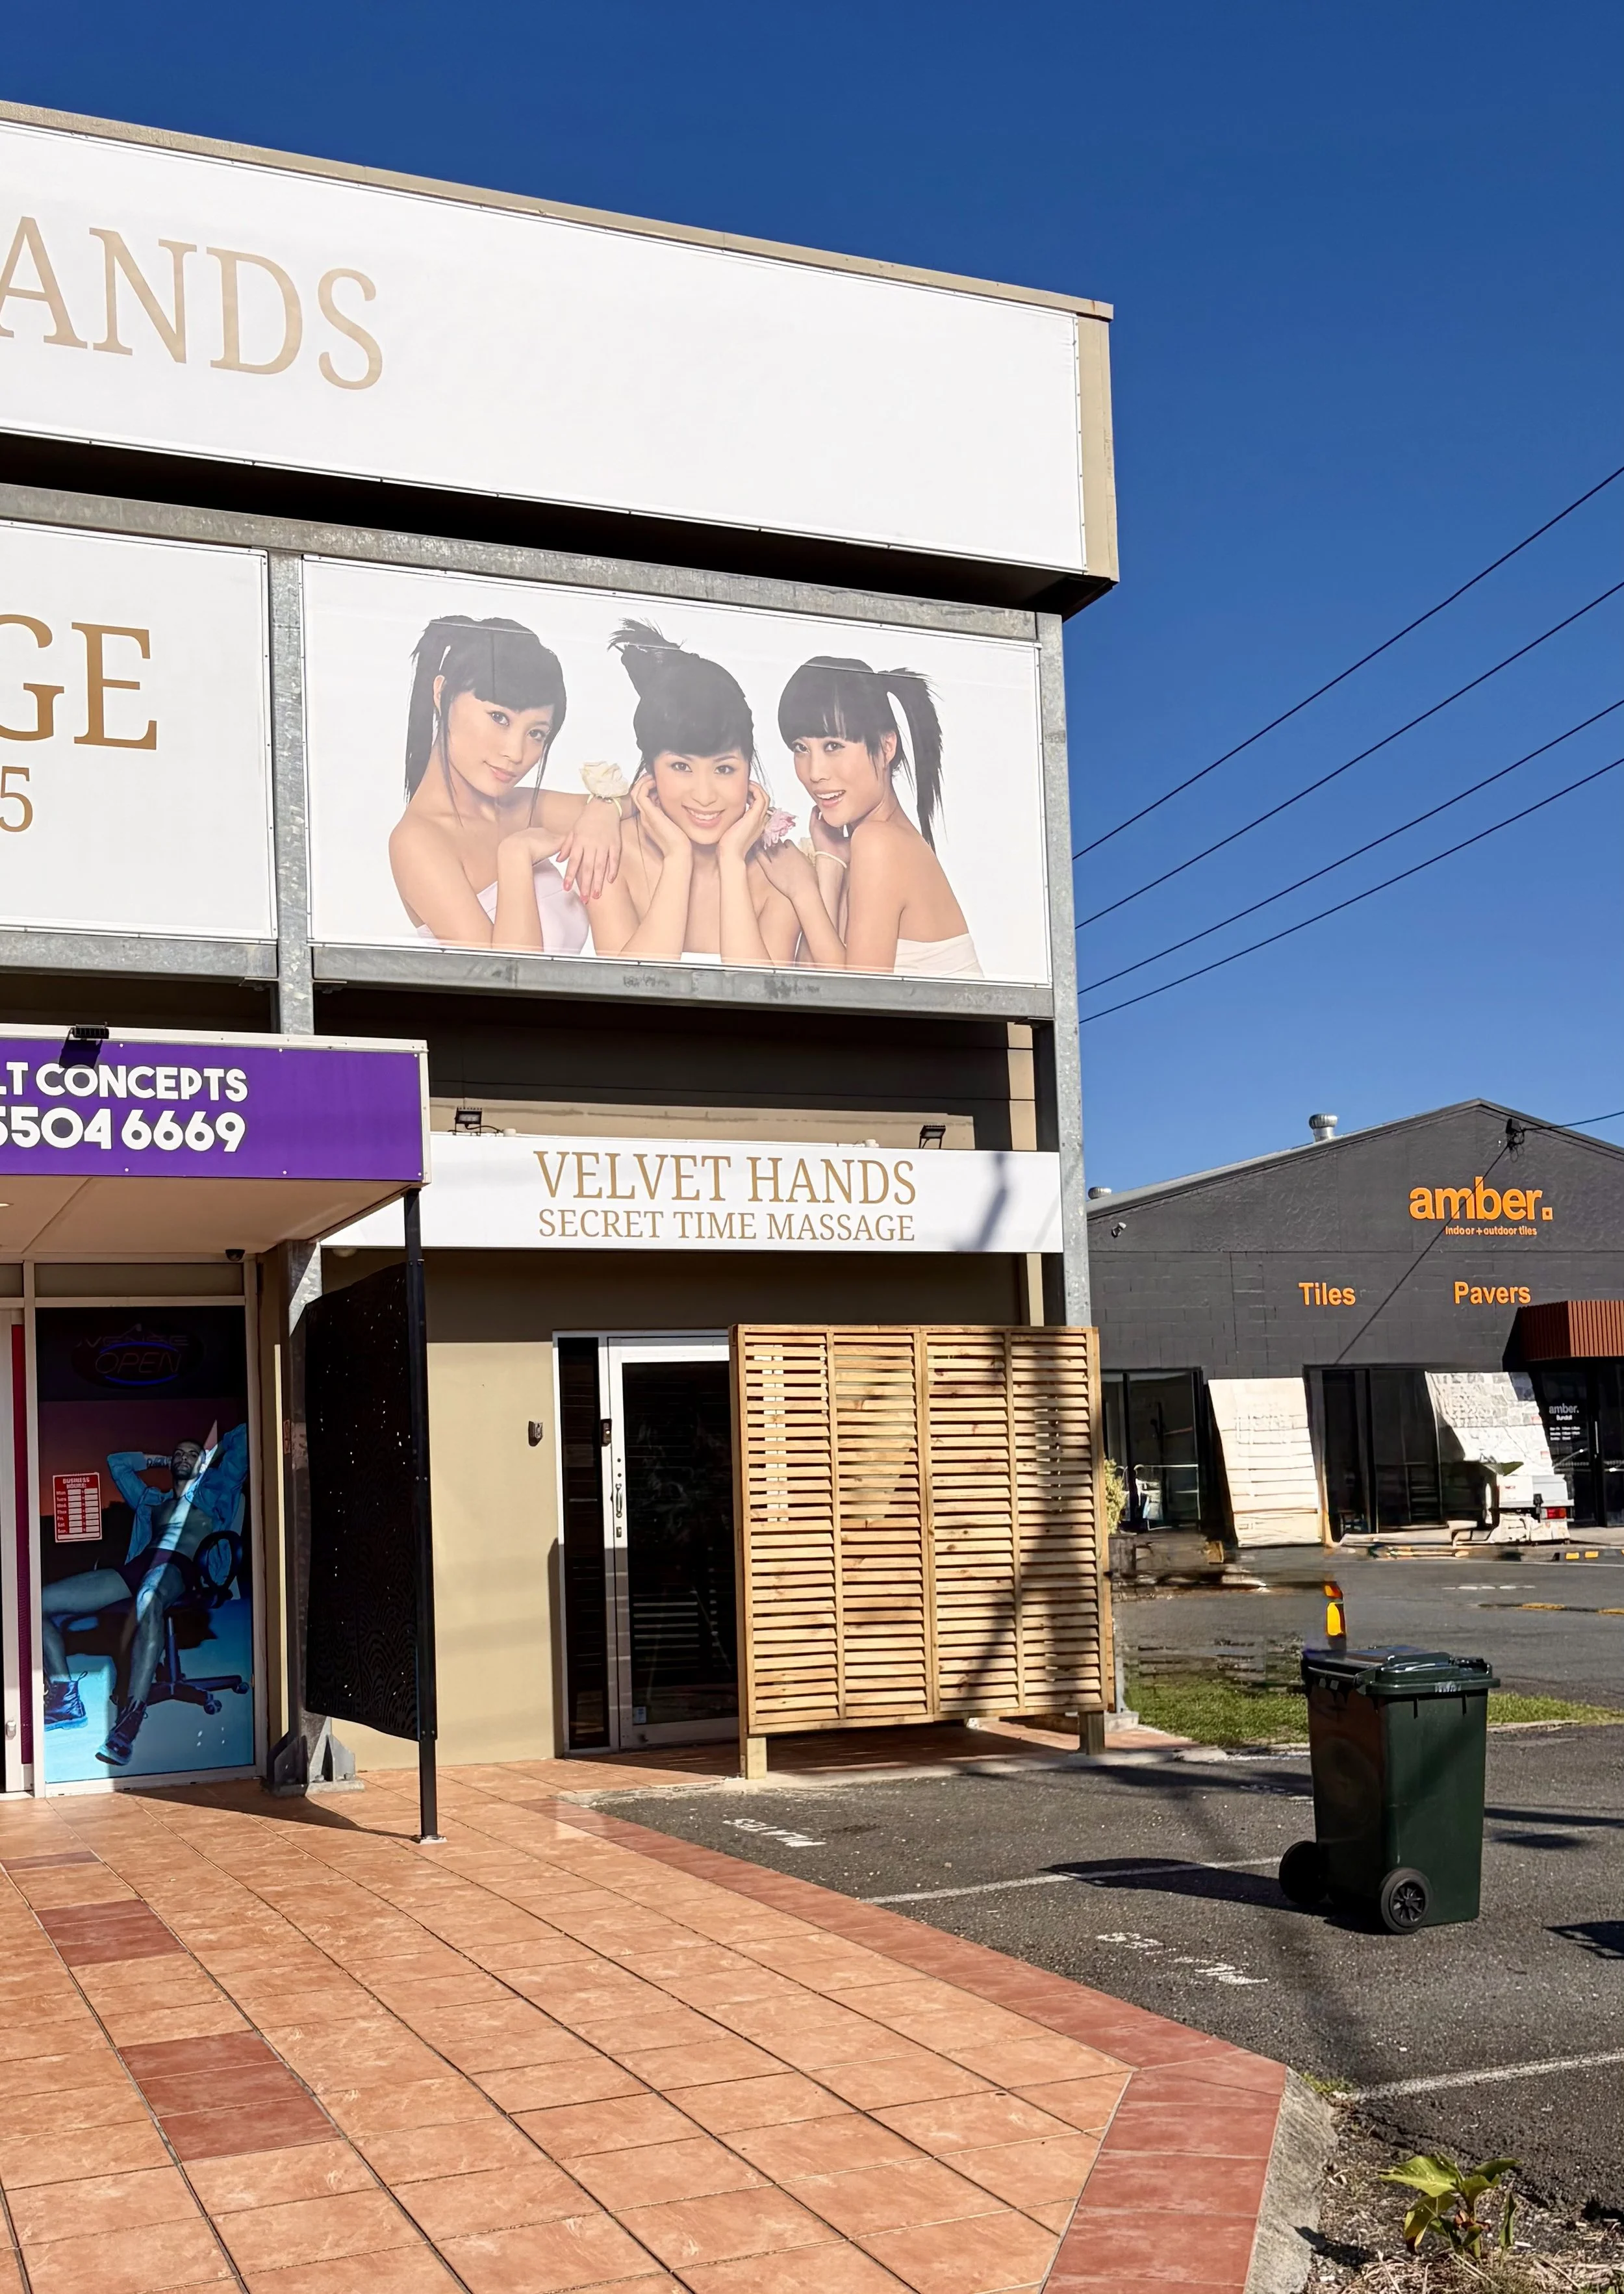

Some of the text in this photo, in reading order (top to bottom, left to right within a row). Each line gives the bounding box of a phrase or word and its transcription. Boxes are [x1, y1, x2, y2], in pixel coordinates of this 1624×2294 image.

[0, 216, 382, 390] ANDS
[0, 613, 157, 751] GE
[0, 765, 33, 832] 5
[0, 1062, 248, 1102] T CONCEPTS
[0, 1106, 246, 1152] 504 6669
[534, 1151, 916, 1205] VELVET HANDS
[539, 1208, 915, 1242] SECRET TIME MASSAGE
[1483, 1226, 1517, 1235] outdoor
[1519, 1225, 1538, 1236] tiles
[1299, 1281, 1531, 1306] Tiles Pavers
[95, 1351, 181, 1374] OPEN
